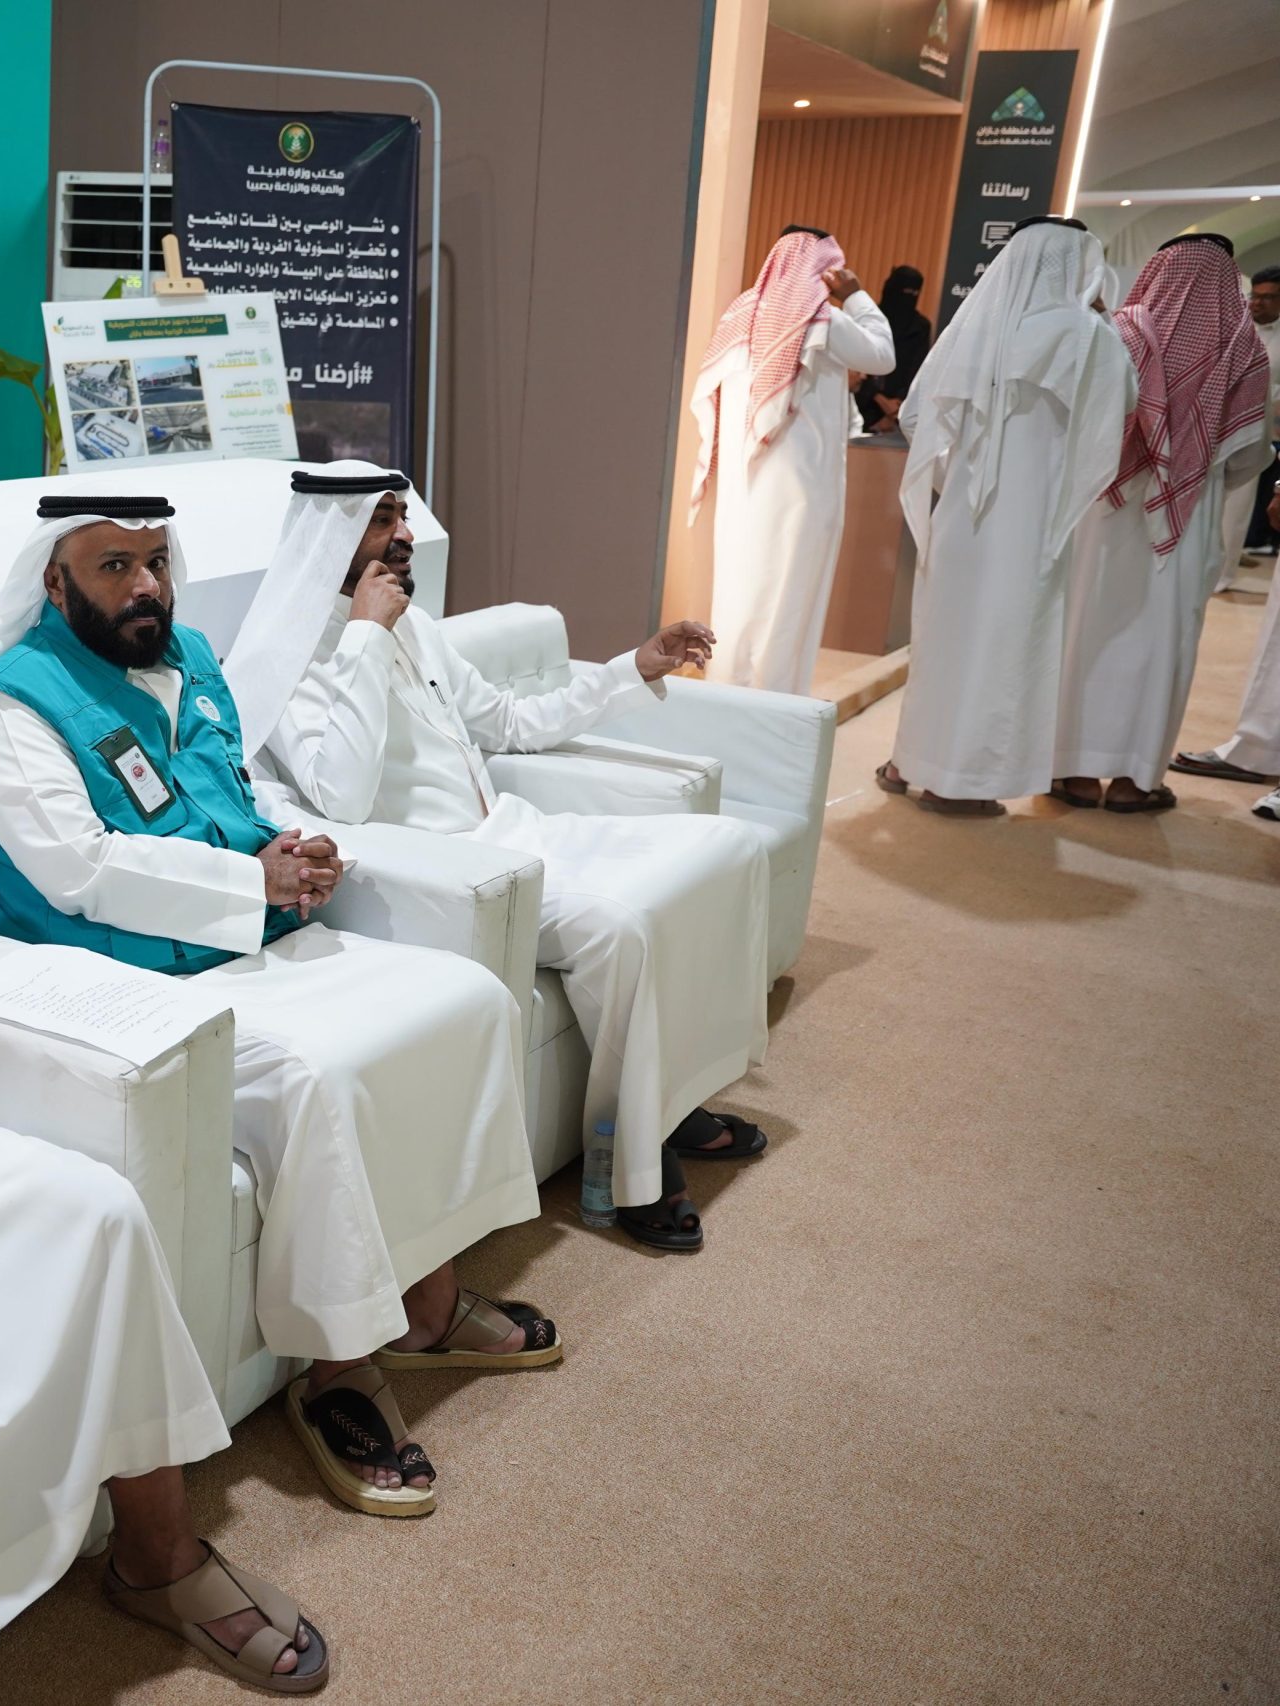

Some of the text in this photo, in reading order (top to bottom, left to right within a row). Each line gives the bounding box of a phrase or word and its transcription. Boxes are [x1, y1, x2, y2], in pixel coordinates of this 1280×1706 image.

[247, 165, 344, 180] مكتب وزارة البيئة
[246, 180, 273, 192] بصبيا
[274, 181, 310, 195] والزراعة
[981, 182, 1030, 201] رسالتنا
[187, 211, 385, 234] نشر الوعي بين فئات المجتمع
[187, 234, 387, 259] تحفيز المسؤولية الفردية والجماعية
[186, 257, 388, 281] المحافظة على البيئة والموارد الطبيعية
[304, 288, 353, 305] السلوكيات
[355, 289, 387, 308] تعزيز
[280, 311, 385, 332] المساهمة في تحقيق
[286, 361, 374, 389] #أرضنا_م
